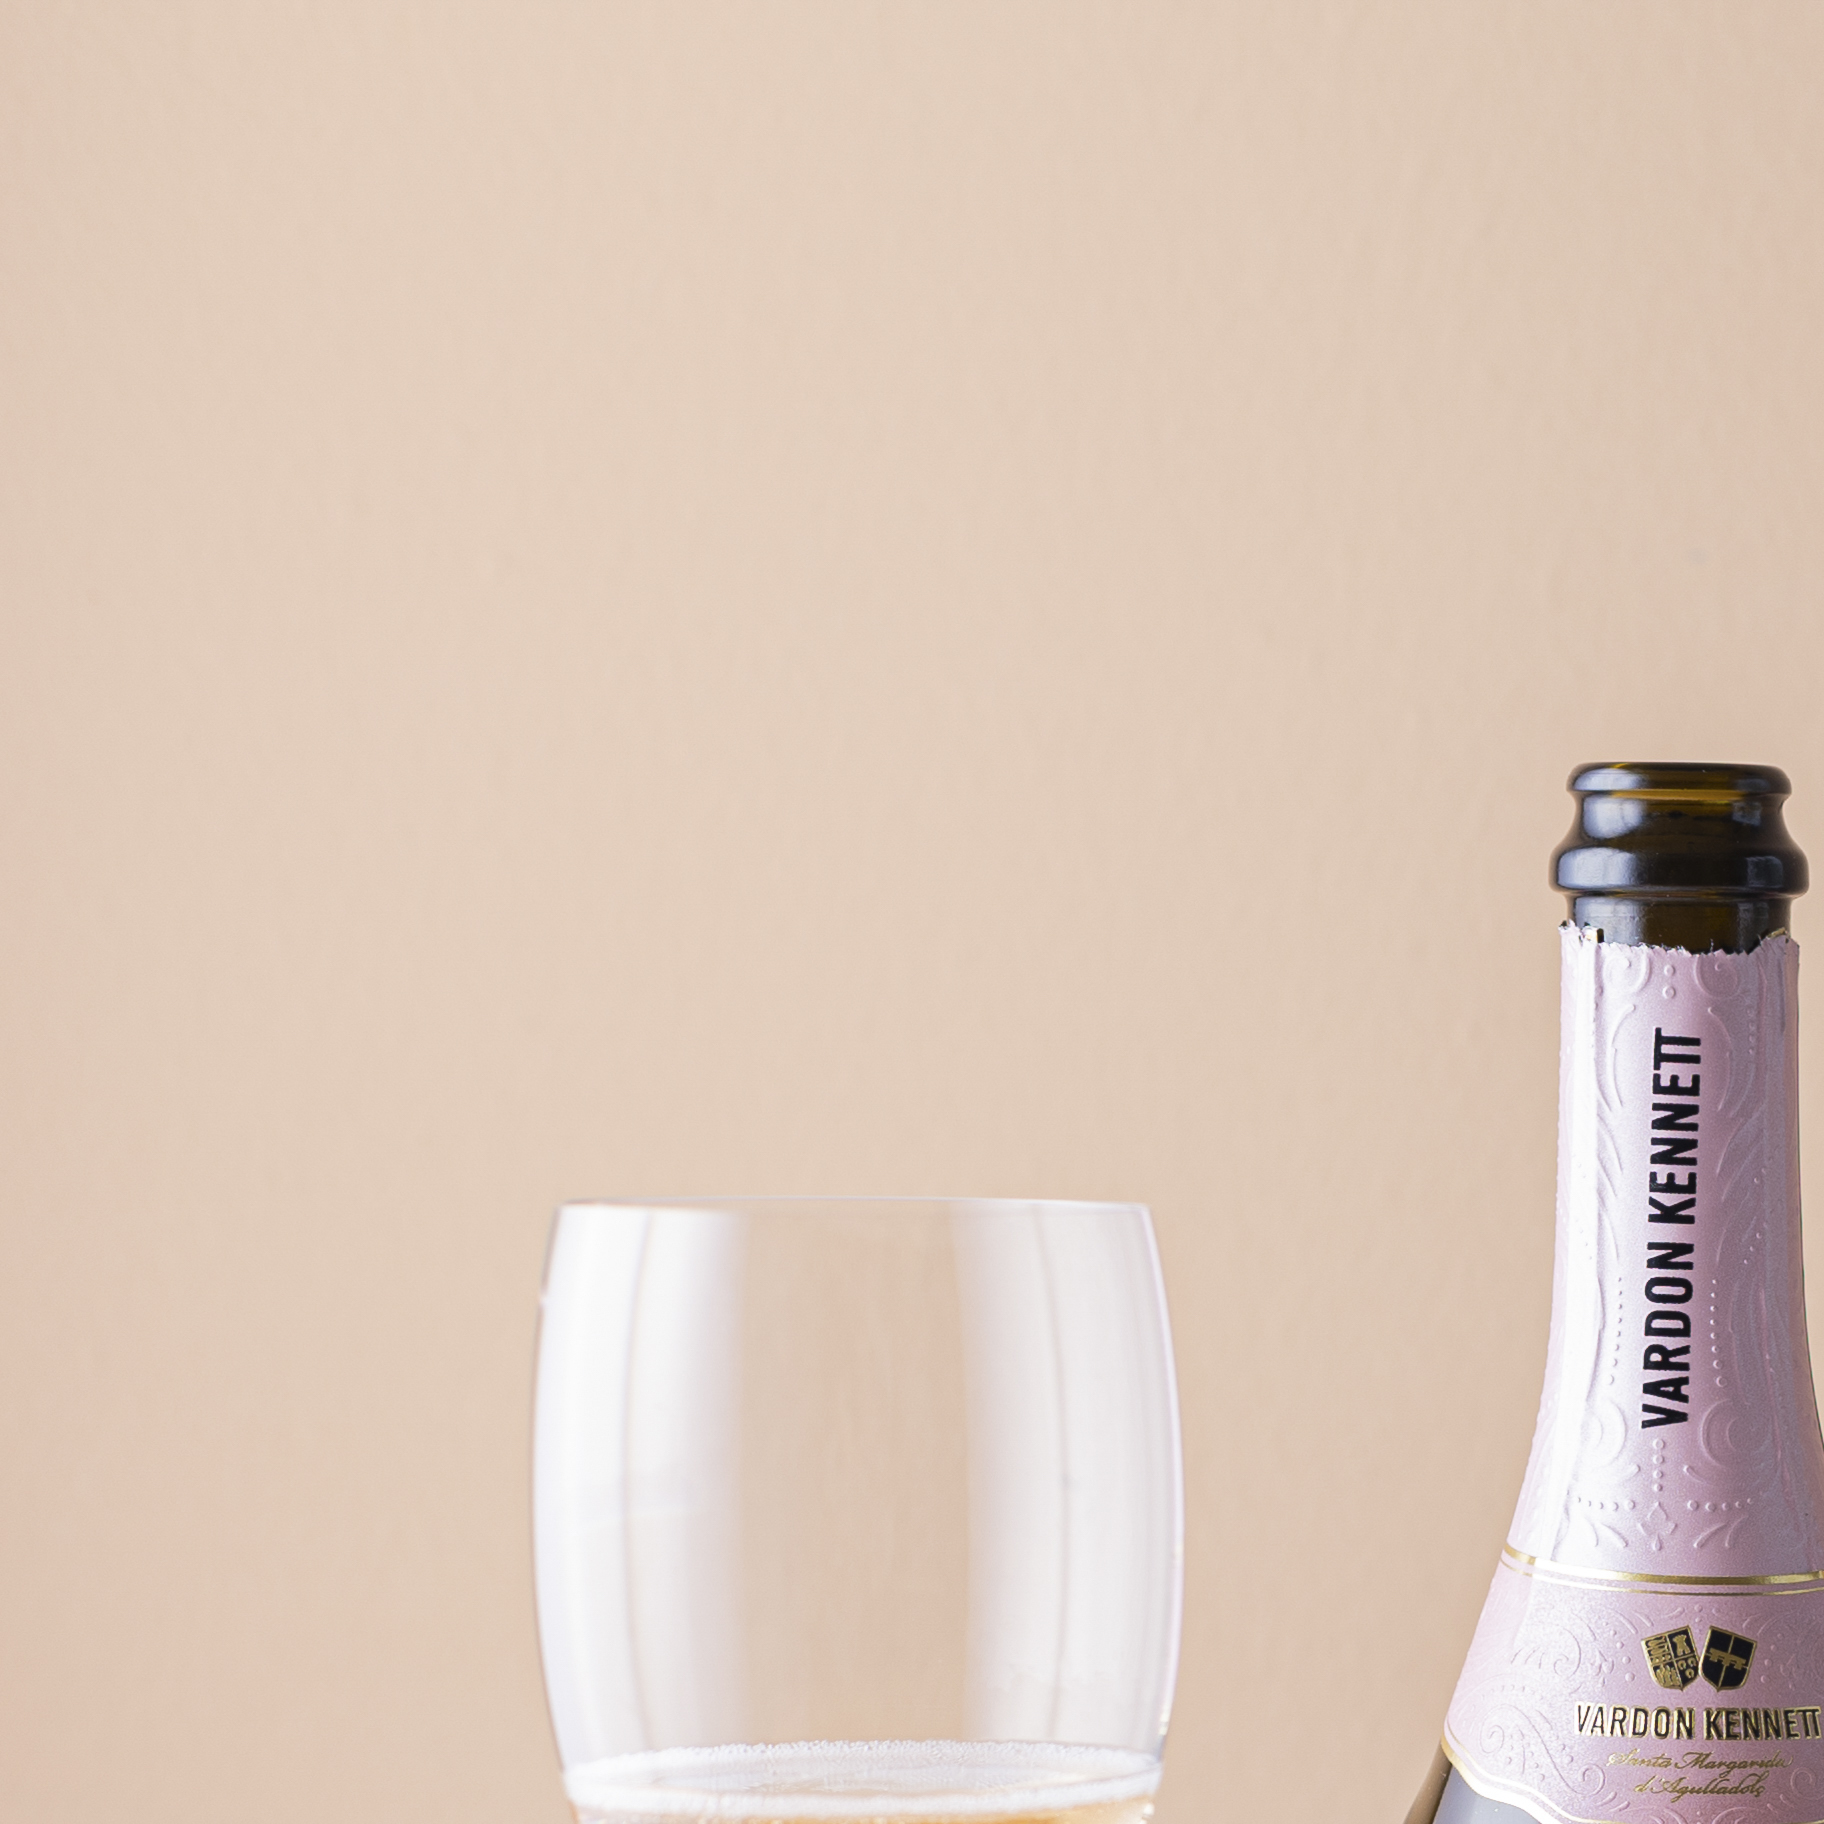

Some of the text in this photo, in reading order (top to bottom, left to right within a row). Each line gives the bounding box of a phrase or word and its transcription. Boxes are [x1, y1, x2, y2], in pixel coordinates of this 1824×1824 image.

[1641, 1027, 1702, 1429] VARDON KENNETT
[1574, 1701, 1822, 1740] VARDON KENNETT
[1606, 1748, 1794, 1778] Santa Margarida
